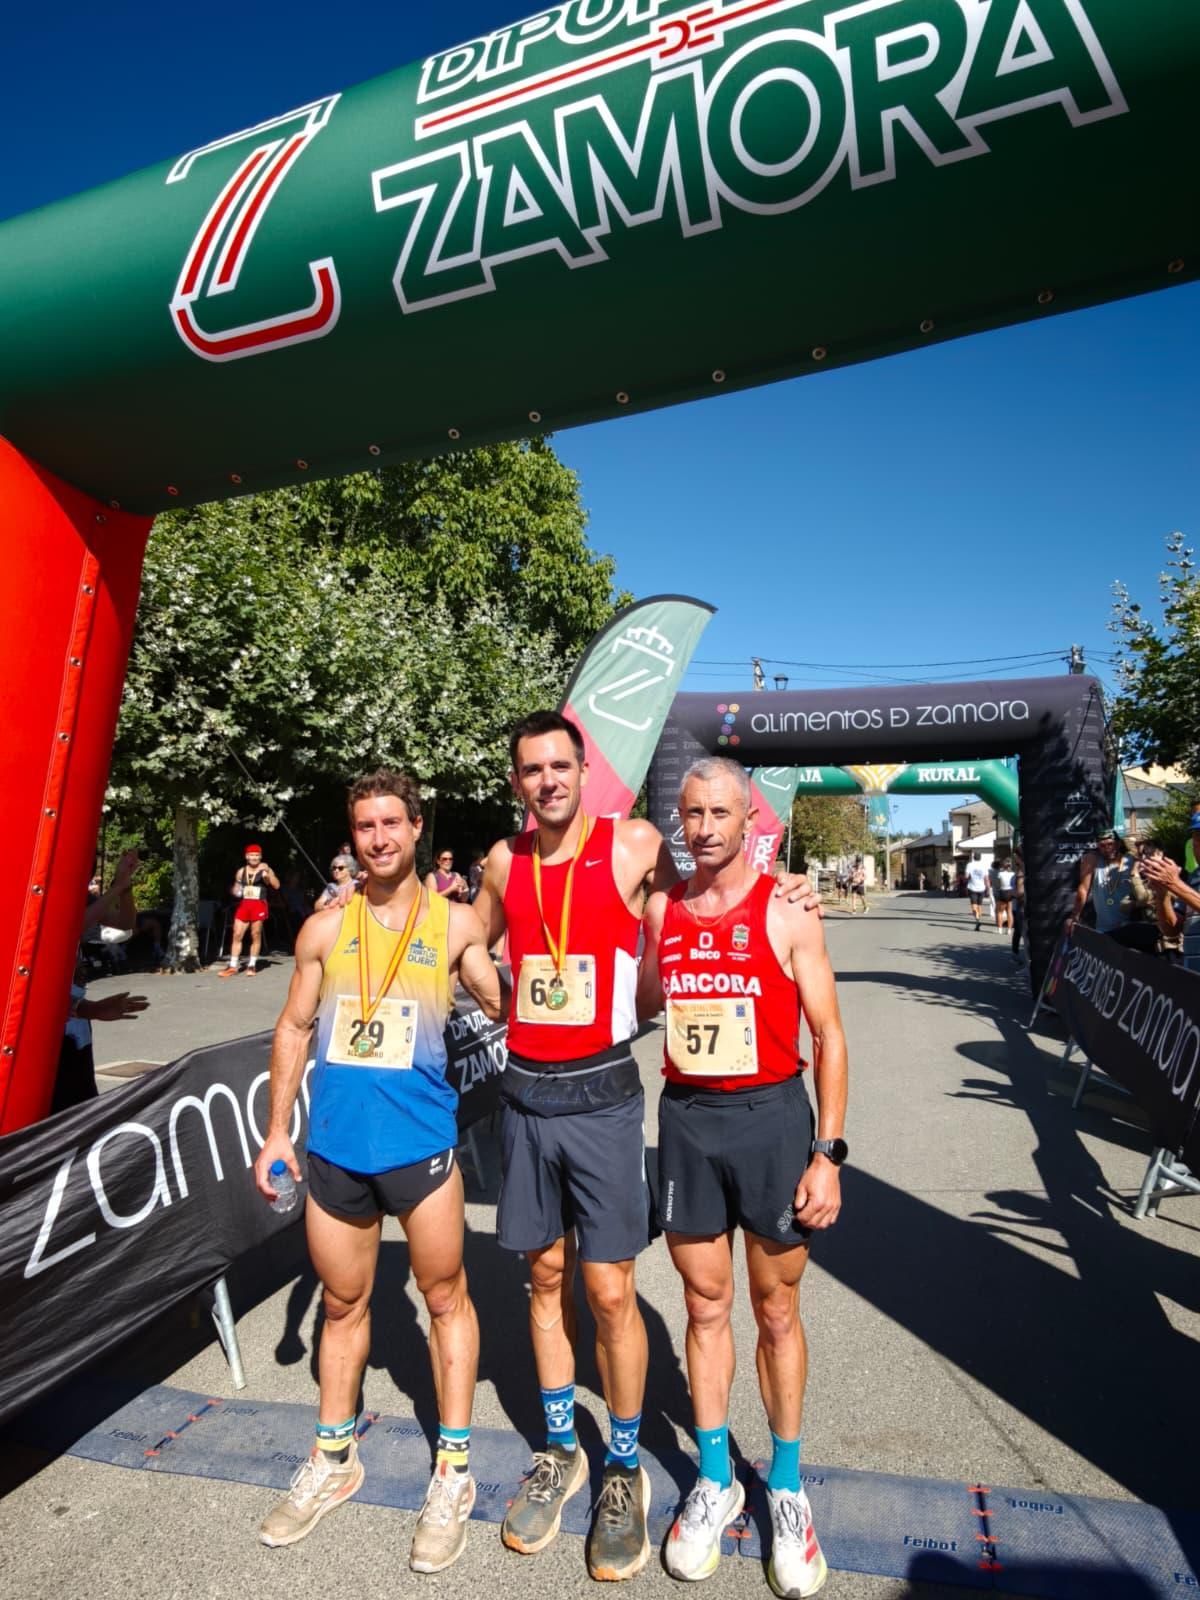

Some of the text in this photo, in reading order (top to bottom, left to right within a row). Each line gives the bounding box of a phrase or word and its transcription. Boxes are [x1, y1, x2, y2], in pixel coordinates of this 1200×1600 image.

[371, 0, 1129, 314] ZAMORA
[751, 709, 883, 734] alimentos
[916, 700, 1029, 725] zamora
[918, 767, 981, 783] RURAL
[407, 954, 437, 967] DUERO
[690, 948, 721, 960] Beco
[662, 970, 762, 996] CÁRCORA
[350, 1019, 384, 1049] 29
[687, 1024, 720, 1055] 57
[108, 1428, 148, 1443] Feibot
[271, 1451, 308, 1464] Feibo
[1010, 1500, 1064, 1515] Feibot
[903, 1535, 958, 1551] Feibot
